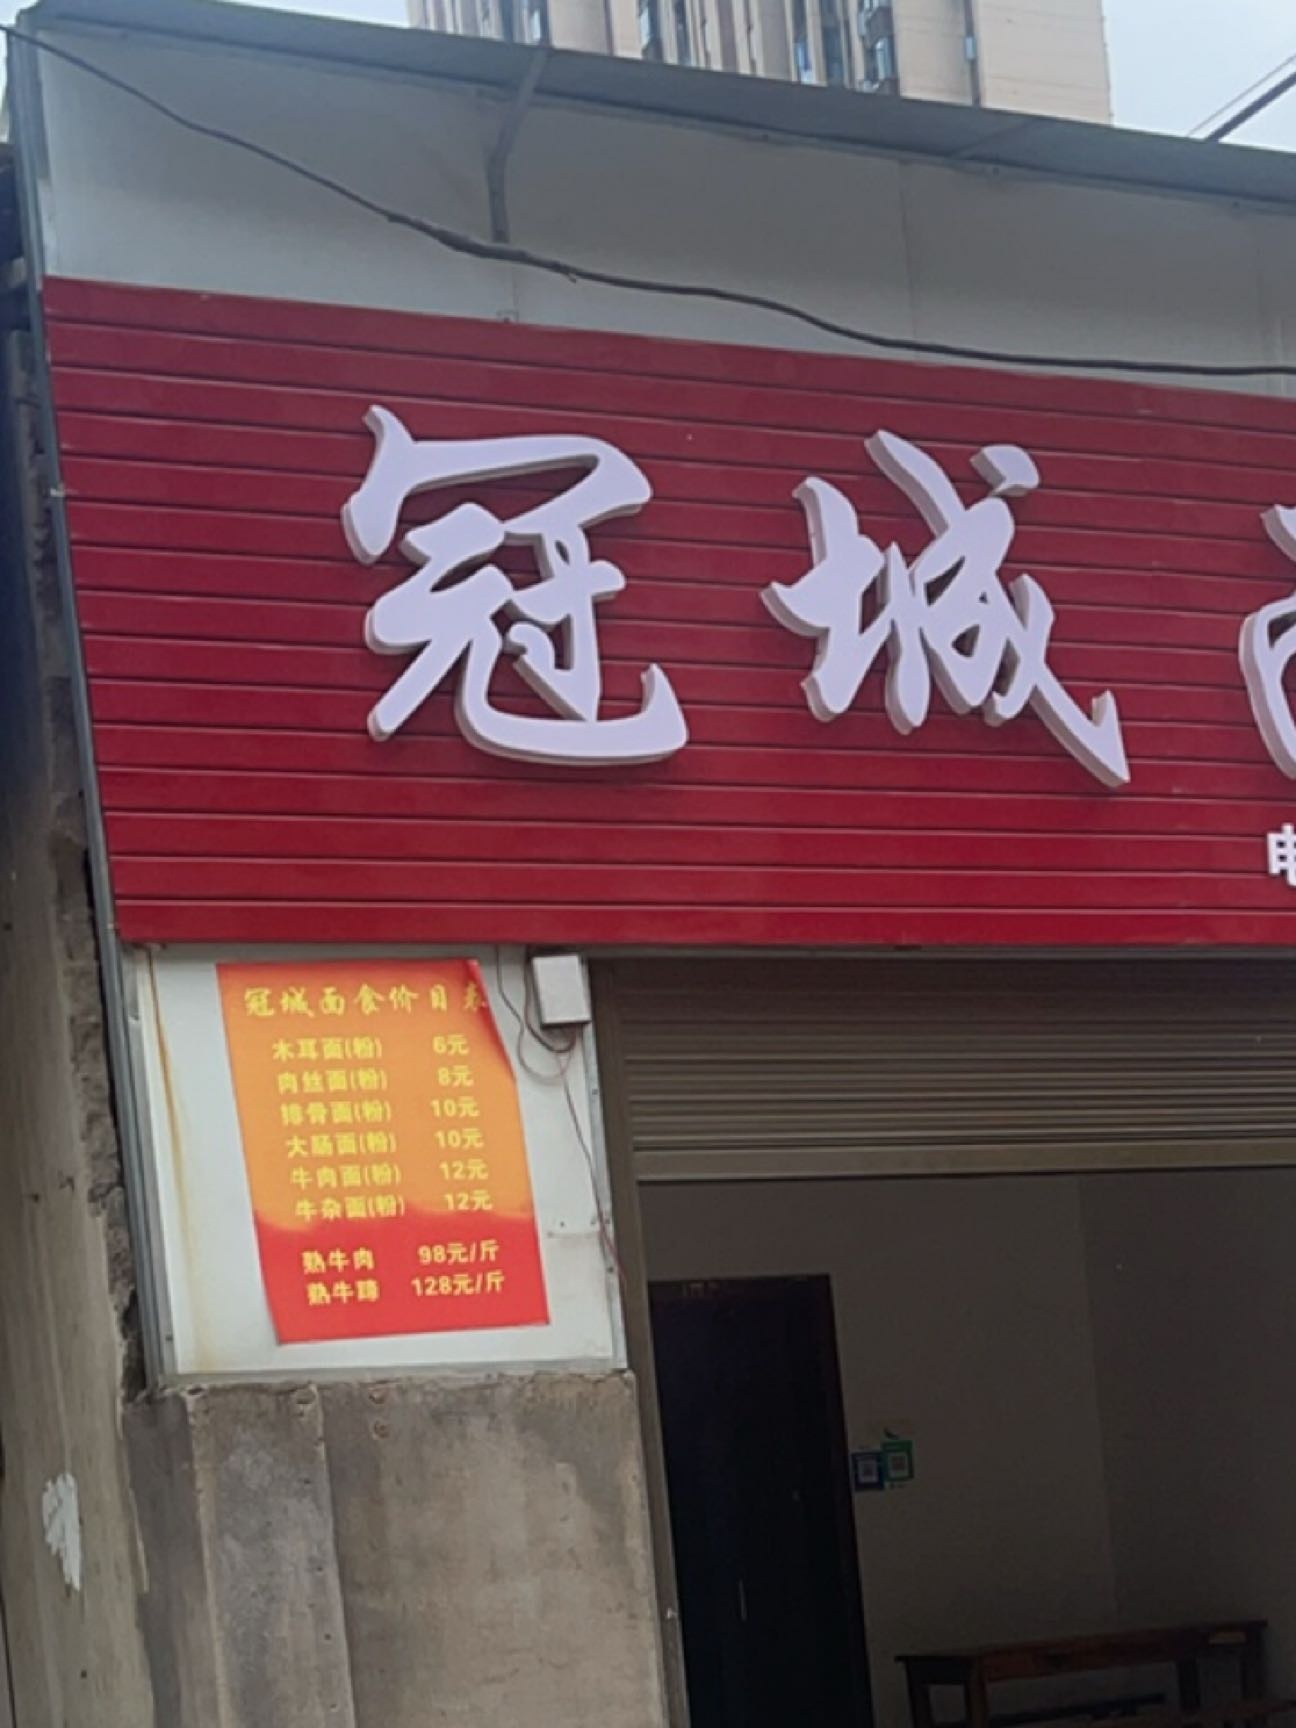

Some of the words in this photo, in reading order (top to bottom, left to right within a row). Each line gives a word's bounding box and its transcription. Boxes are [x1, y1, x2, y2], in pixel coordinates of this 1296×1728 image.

[273, 1036, 382, 1061] 木耳面(粉)
[433, 1034, 469, 1057] 6元
[278, 1068, 388, 1094] 肉丝面(粉)
[439, 1066, 474, 1087] 8元
[281, 1100, 392, 1126] 排骨面(粉)
[431, 1097, 480, 1119] 10元
[435, 1129, 484, 1150] 10元
[290, 1164, 402, 1190] 牛肉面(粉)
[440, 1161, 489, 1182] 12元
[295, 1196, 405, 1222] 牛杂面(粉)
[445, 1191, 494, 1213] 12元
[302, 1247, 375, 1275] 熟牛肉
[418, 1239, 500, 1266] 98元/斤
[412, 1271, 506, 1297] 128元/斤
